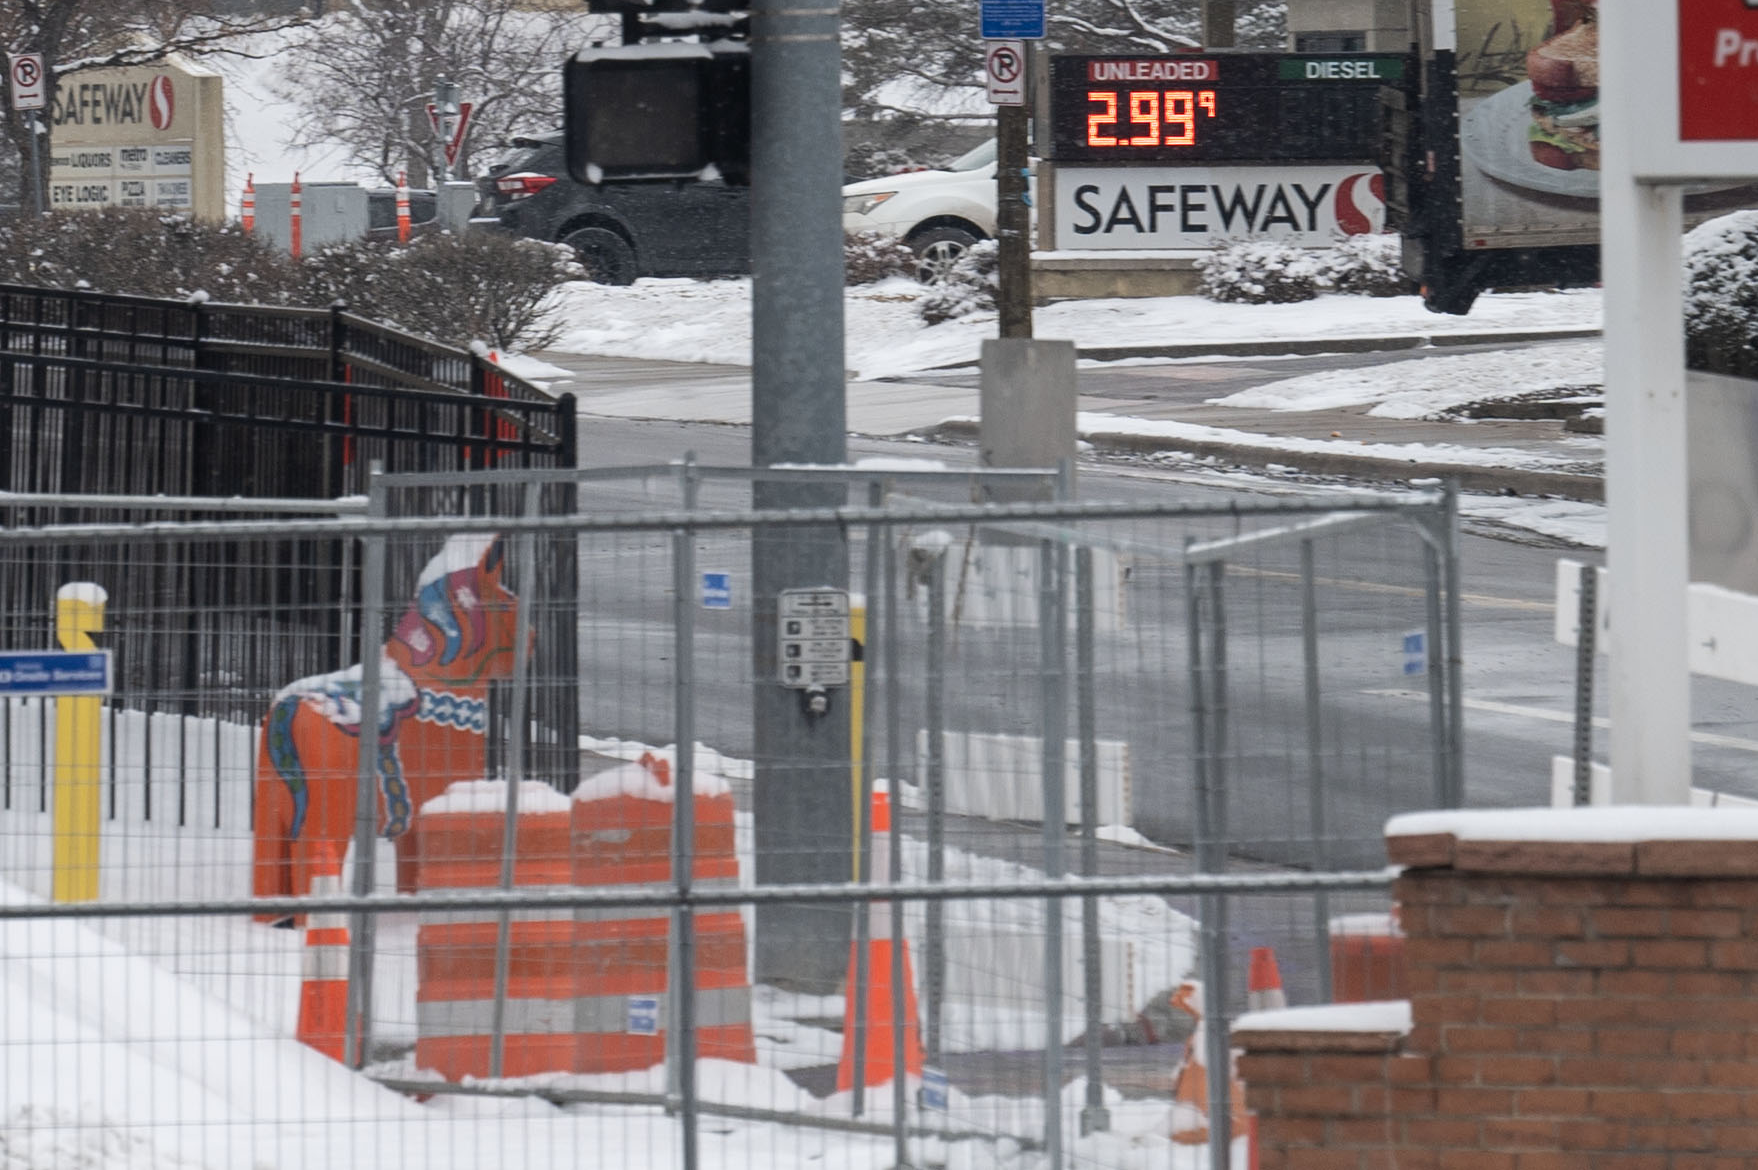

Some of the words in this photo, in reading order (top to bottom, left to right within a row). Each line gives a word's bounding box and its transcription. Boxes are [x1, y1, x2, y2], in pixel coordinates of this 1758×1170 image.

[1094, 60, 1210, 81] UNLEADED
[1305, 60, 1381, 79] DIESEL
[53, 82, 147, 126] SAFEWAY
[71, 152, 113, 168] LIQUORS
[53, 185, 74, 203] EYE
[76, 185, 109, 203] LOGIC
[1073, 183, 1332, 235] SAFEWAY
